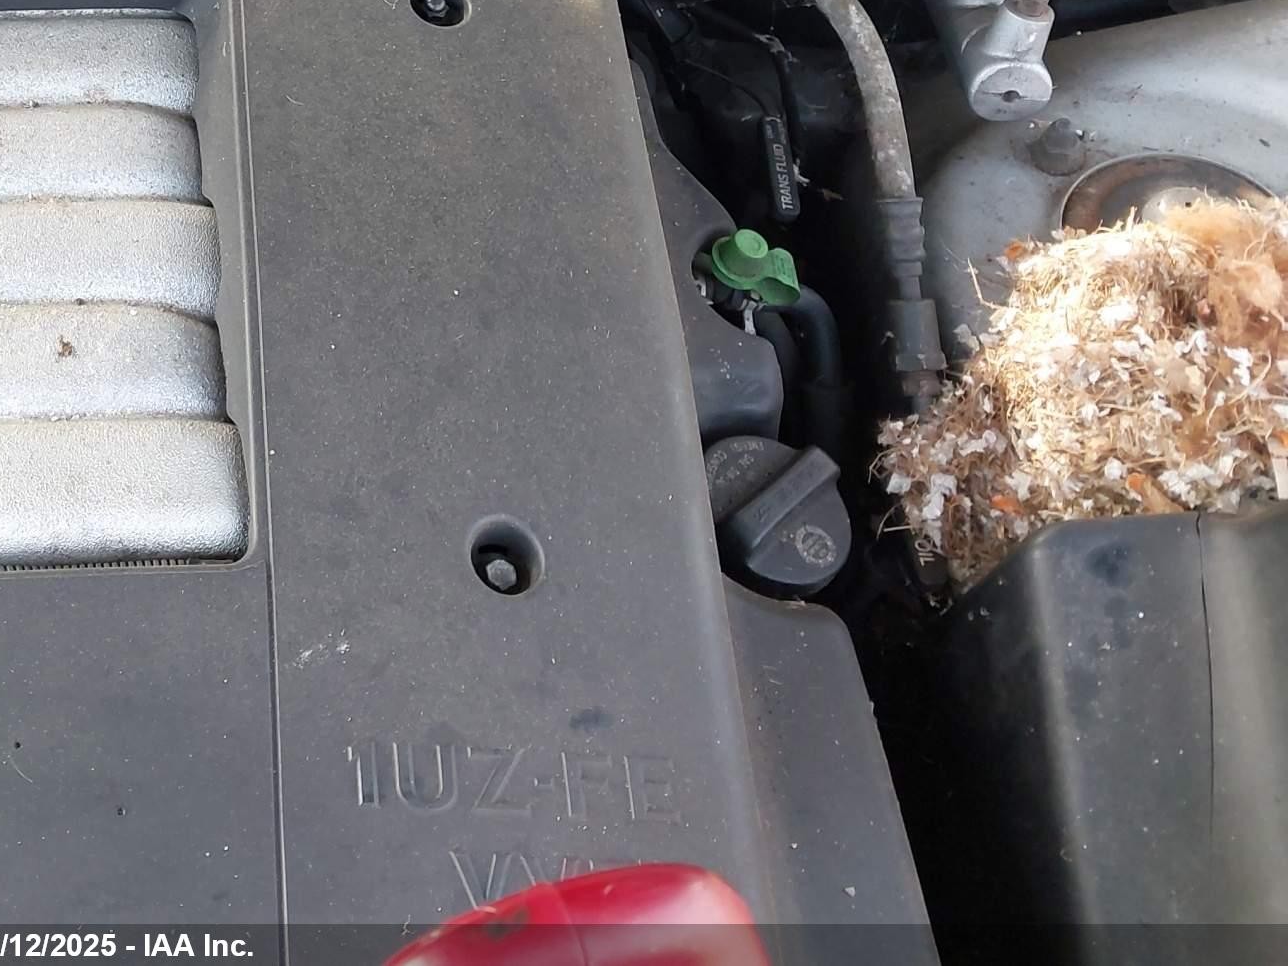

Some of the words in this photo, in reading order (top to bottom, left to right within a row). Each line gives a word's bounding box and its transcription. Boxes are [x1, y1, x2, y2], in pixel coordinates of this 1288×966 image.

[777, 174, 794, 210] TRANS
[914, 538, 935, 566] OIL
[346, 741, 682, 825] 1UZ-FE
